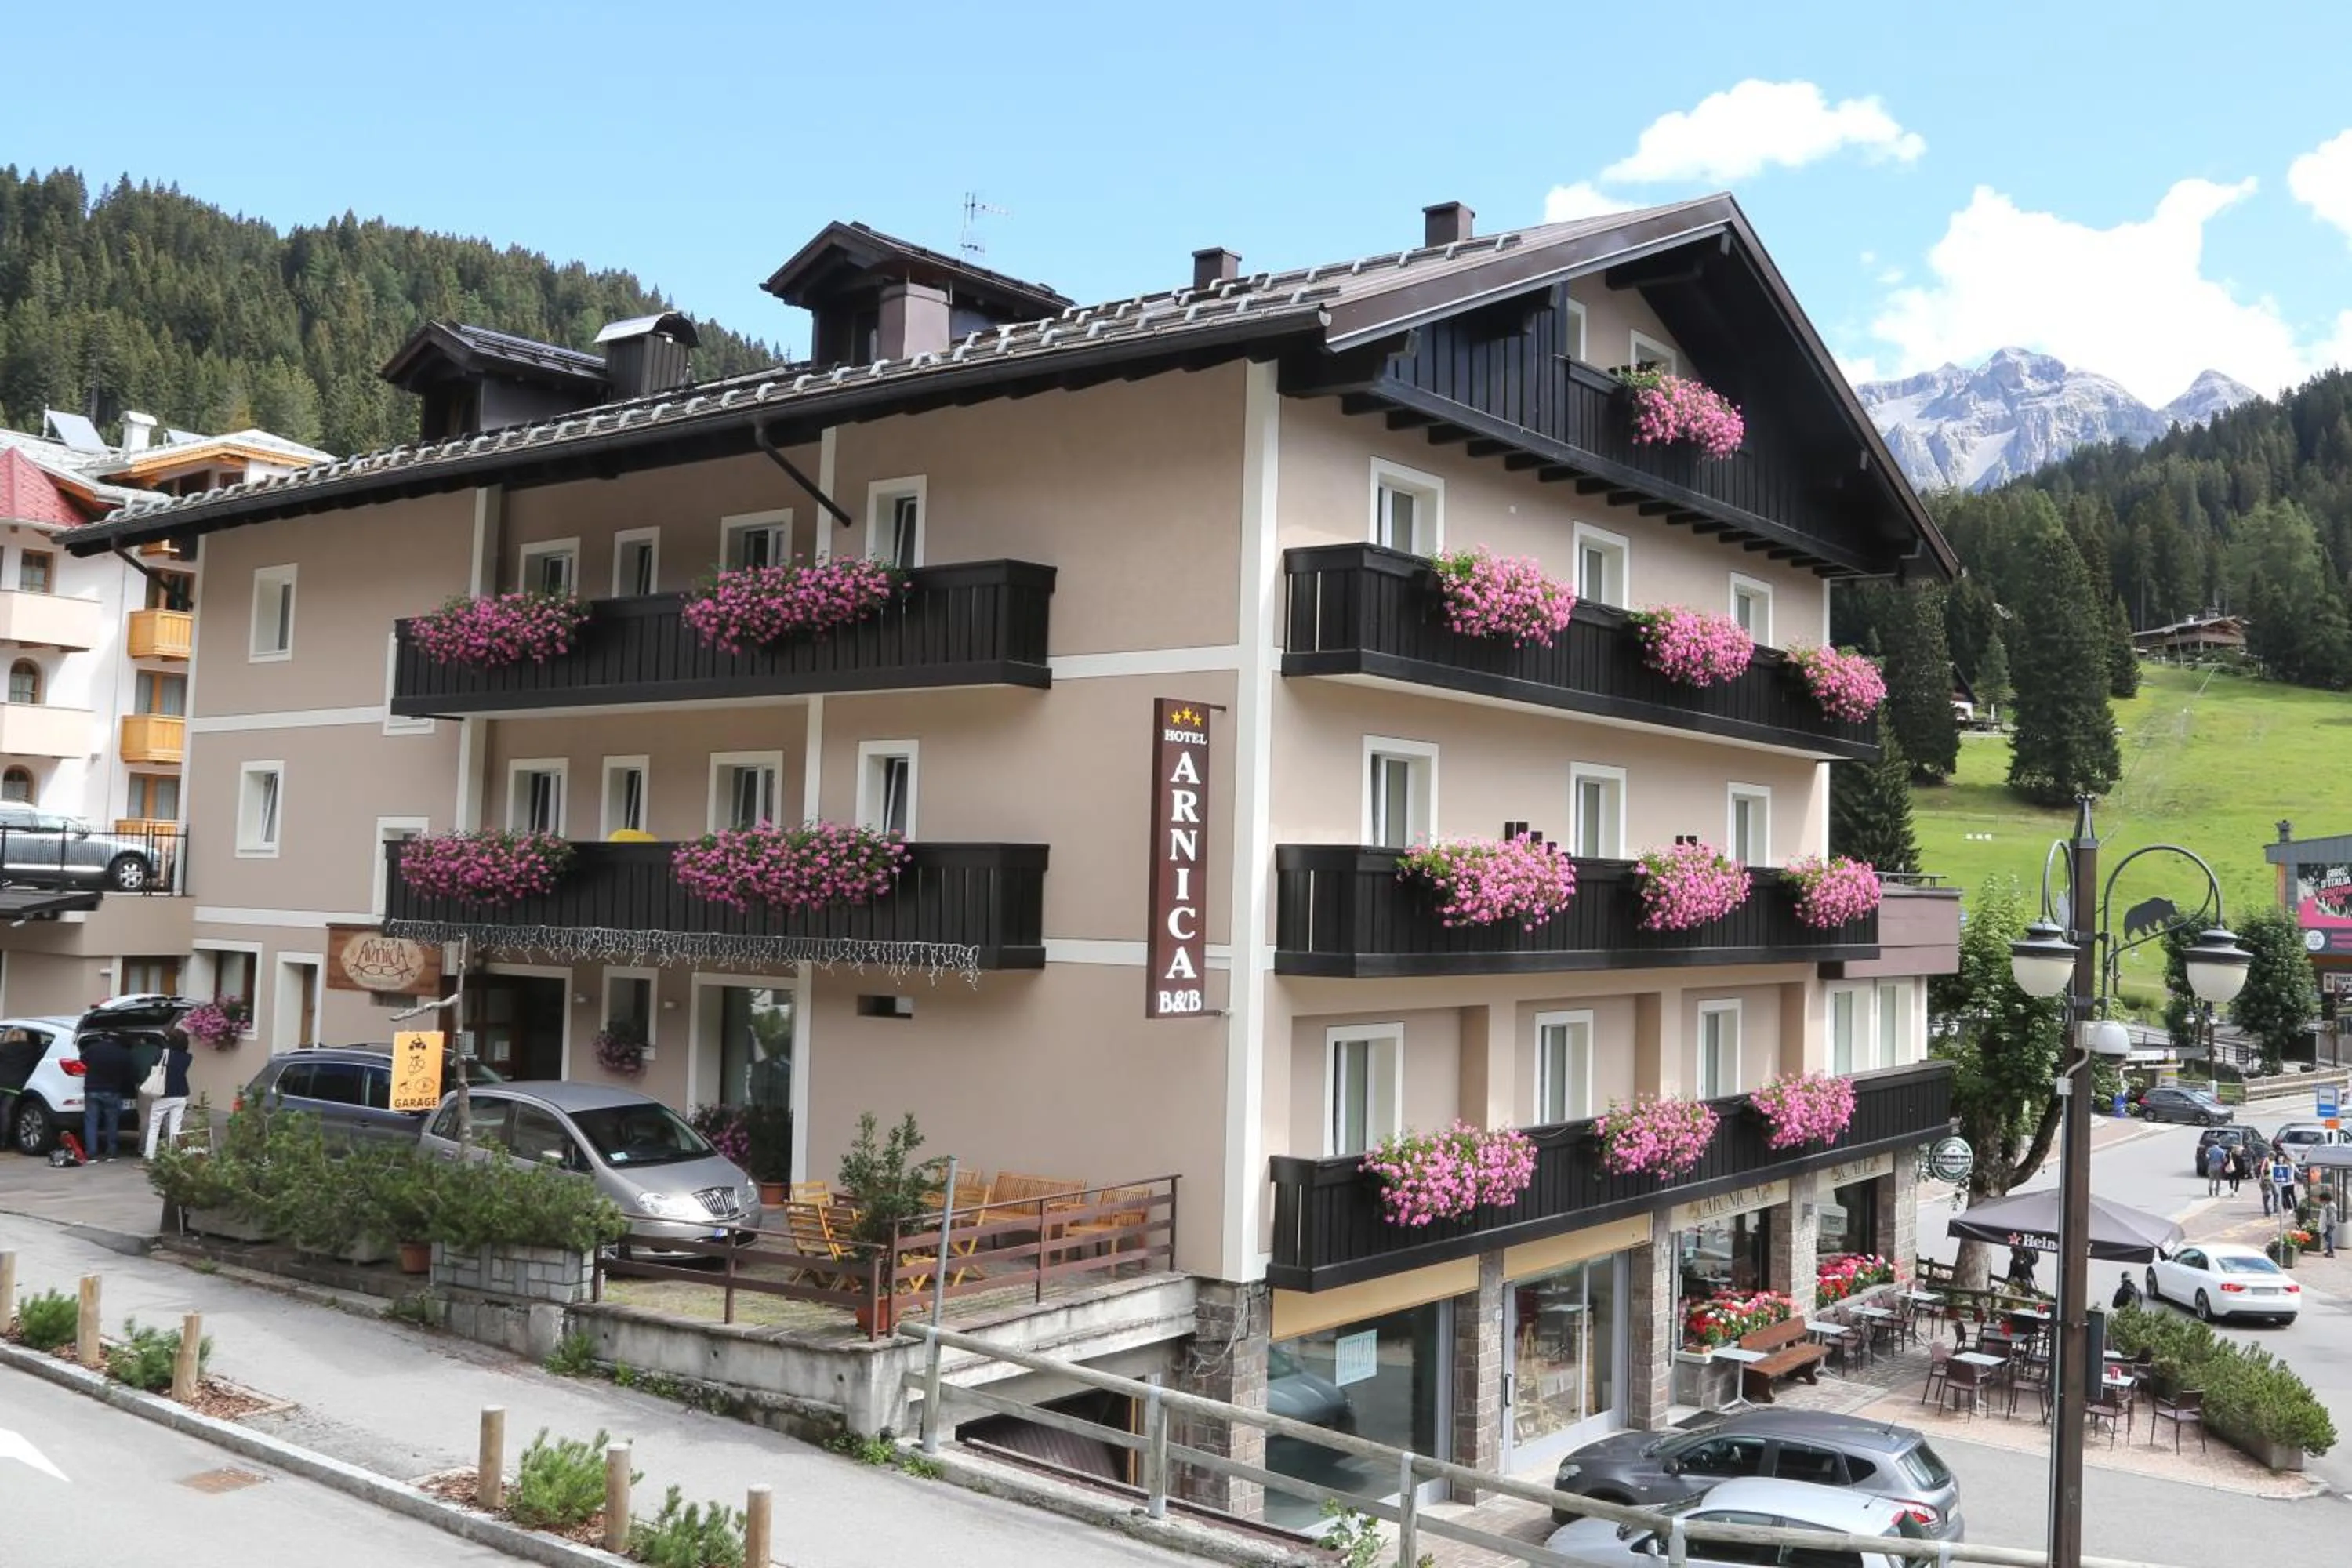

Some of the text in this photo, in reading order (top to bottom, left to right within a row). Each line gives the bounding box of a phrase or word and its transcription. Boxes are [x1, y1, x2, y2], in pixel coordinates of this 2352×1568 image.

[1164, 729, 1207, 745] HOTEL
[1164, 750, 1200, 979] ARNICA
[1158, 989, 1202, 1014] B&B
[394, 1097, 437, 1108] GARAGE
